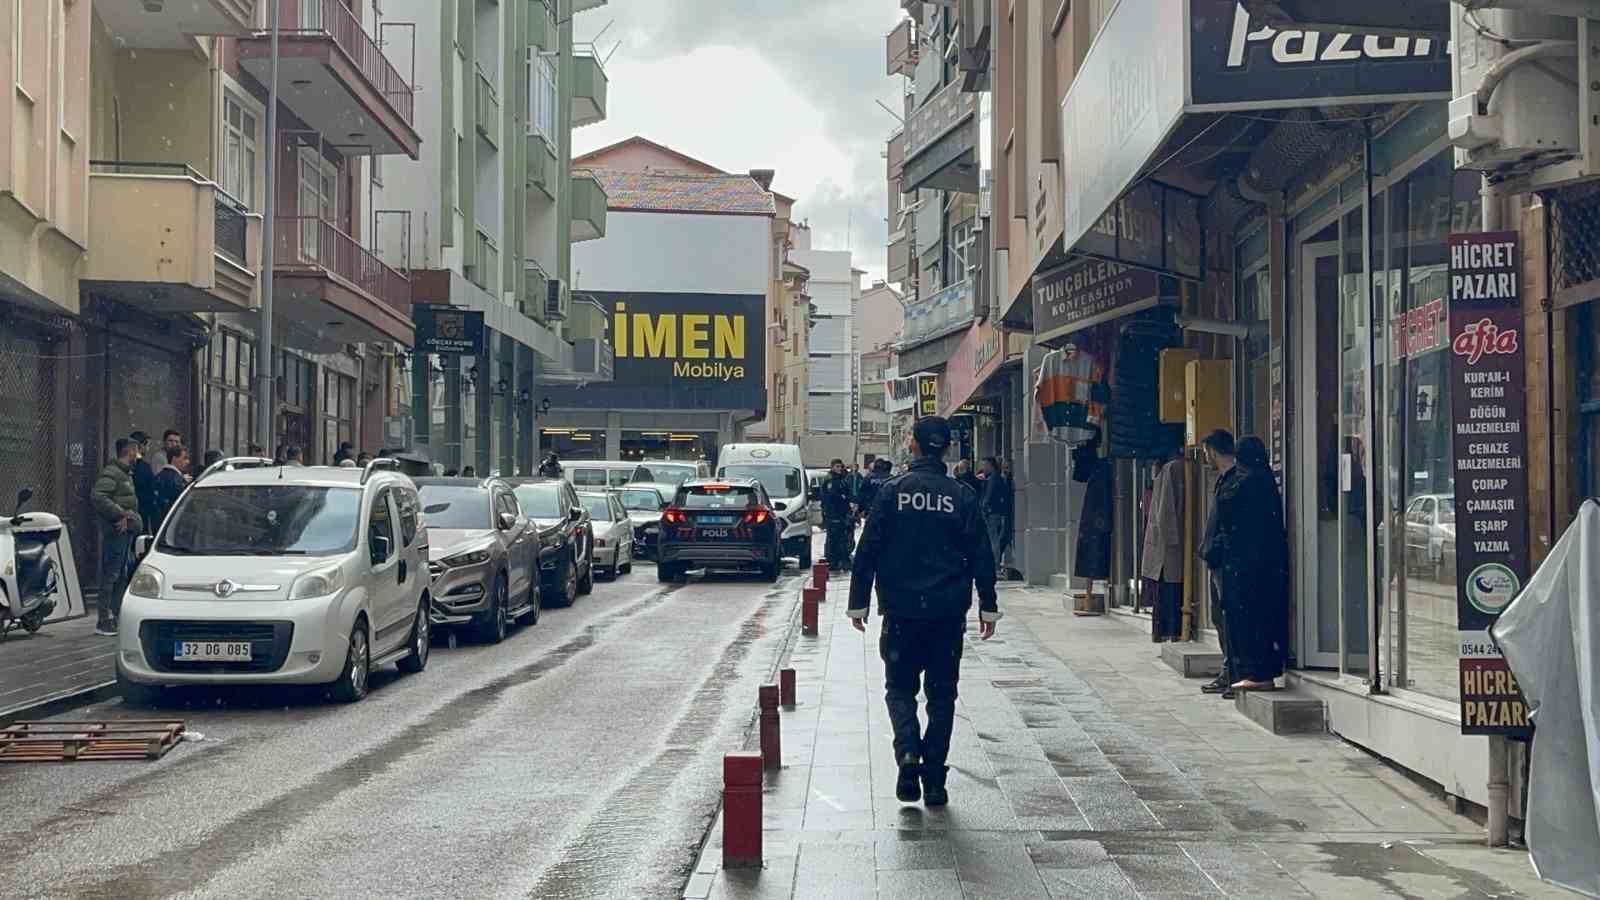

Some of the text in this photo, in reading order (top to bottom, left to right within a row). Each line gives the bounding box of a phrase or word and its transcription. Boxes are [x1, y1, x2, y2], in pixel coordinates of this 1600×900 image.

[1451, 240, 1515, 270] HİCRET
[1452, 273, 1517, 300] PAZARI
[1453, 318, 1518, 365] afia
[673, 362, 744, 381] Mobilya
[1470, 384, 1504, 398] KERİM
[1470, 405, 1506, 418] DÜĞÜN
[1456, 420, 1520, 434] MALZEMELERİ
[1468, 443, 1509, 455] CENAZE
[1457, 456, 1521, 470] MALZEMELERİ
[1472, 479, 1508, 492] ÇORAP
[897, 491, 955, 513] POLİS
[1466, 499, 1514, 514] ÇAMAŞIR
[702, 528, 728, 538] POLİS
[1474, 520, 1508, 534] EŞARP
[1474, 541, 1510, 553] YAZMA
[185, 643, 249, 656] 32 DG 085
[1461, 643, 1485, 656] 0544
